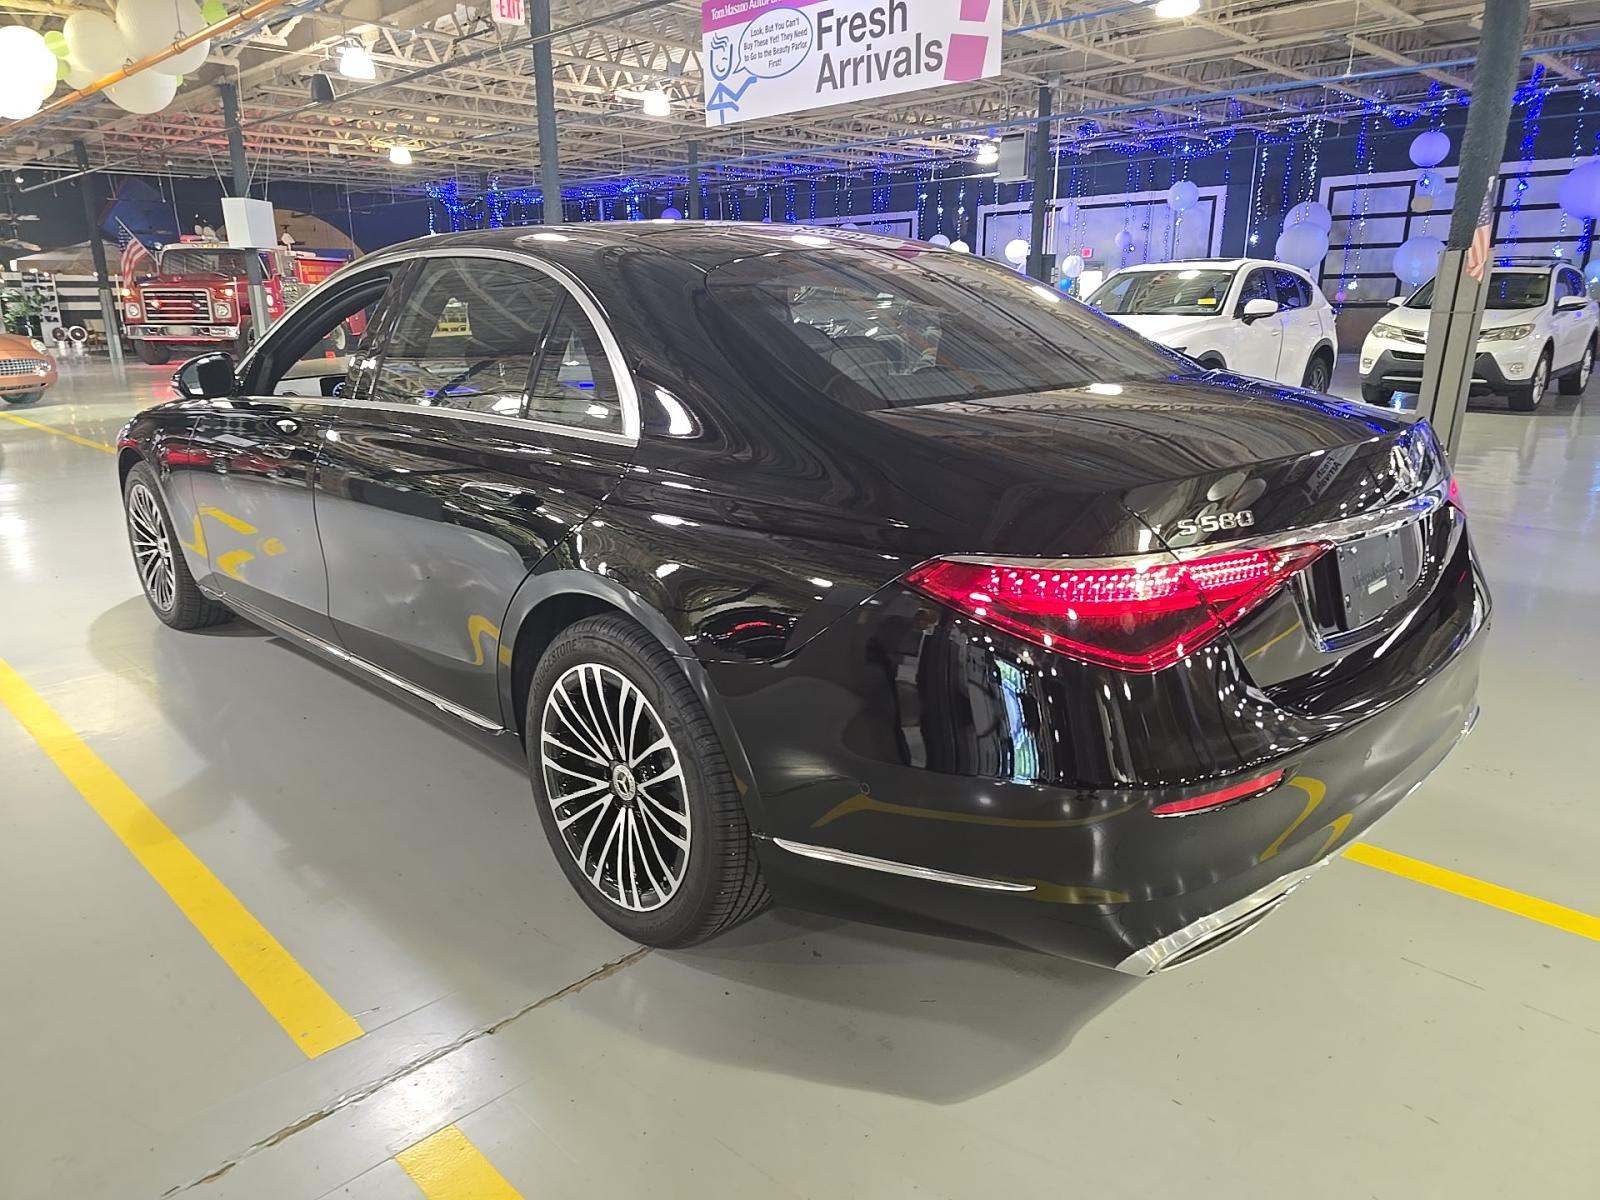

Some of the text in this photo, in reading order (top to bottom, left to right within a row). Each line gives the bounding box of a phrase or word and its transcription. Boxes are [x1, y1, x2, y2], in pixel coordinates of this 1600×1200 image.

[500, 0, 520, 19] EXIT
[765, 24, 774, 33] But
[775, 22, 784, 31] You
[817, 0, 908, 51] Fresh
[743, 42, 753, 51] Buy
[754, 38, 769, 47] These
[780, 32, 793, 41] They
[794, 28, 808, 38] Need
[744, 54, 749, 62] to
[750, 52, 757, 60] Go
[758, 51, 763, 59] to
[764, 49, 772, 57] the
[773, 45, 790, 55] Beauty
[815, 32, 943, 94] Arrivals
